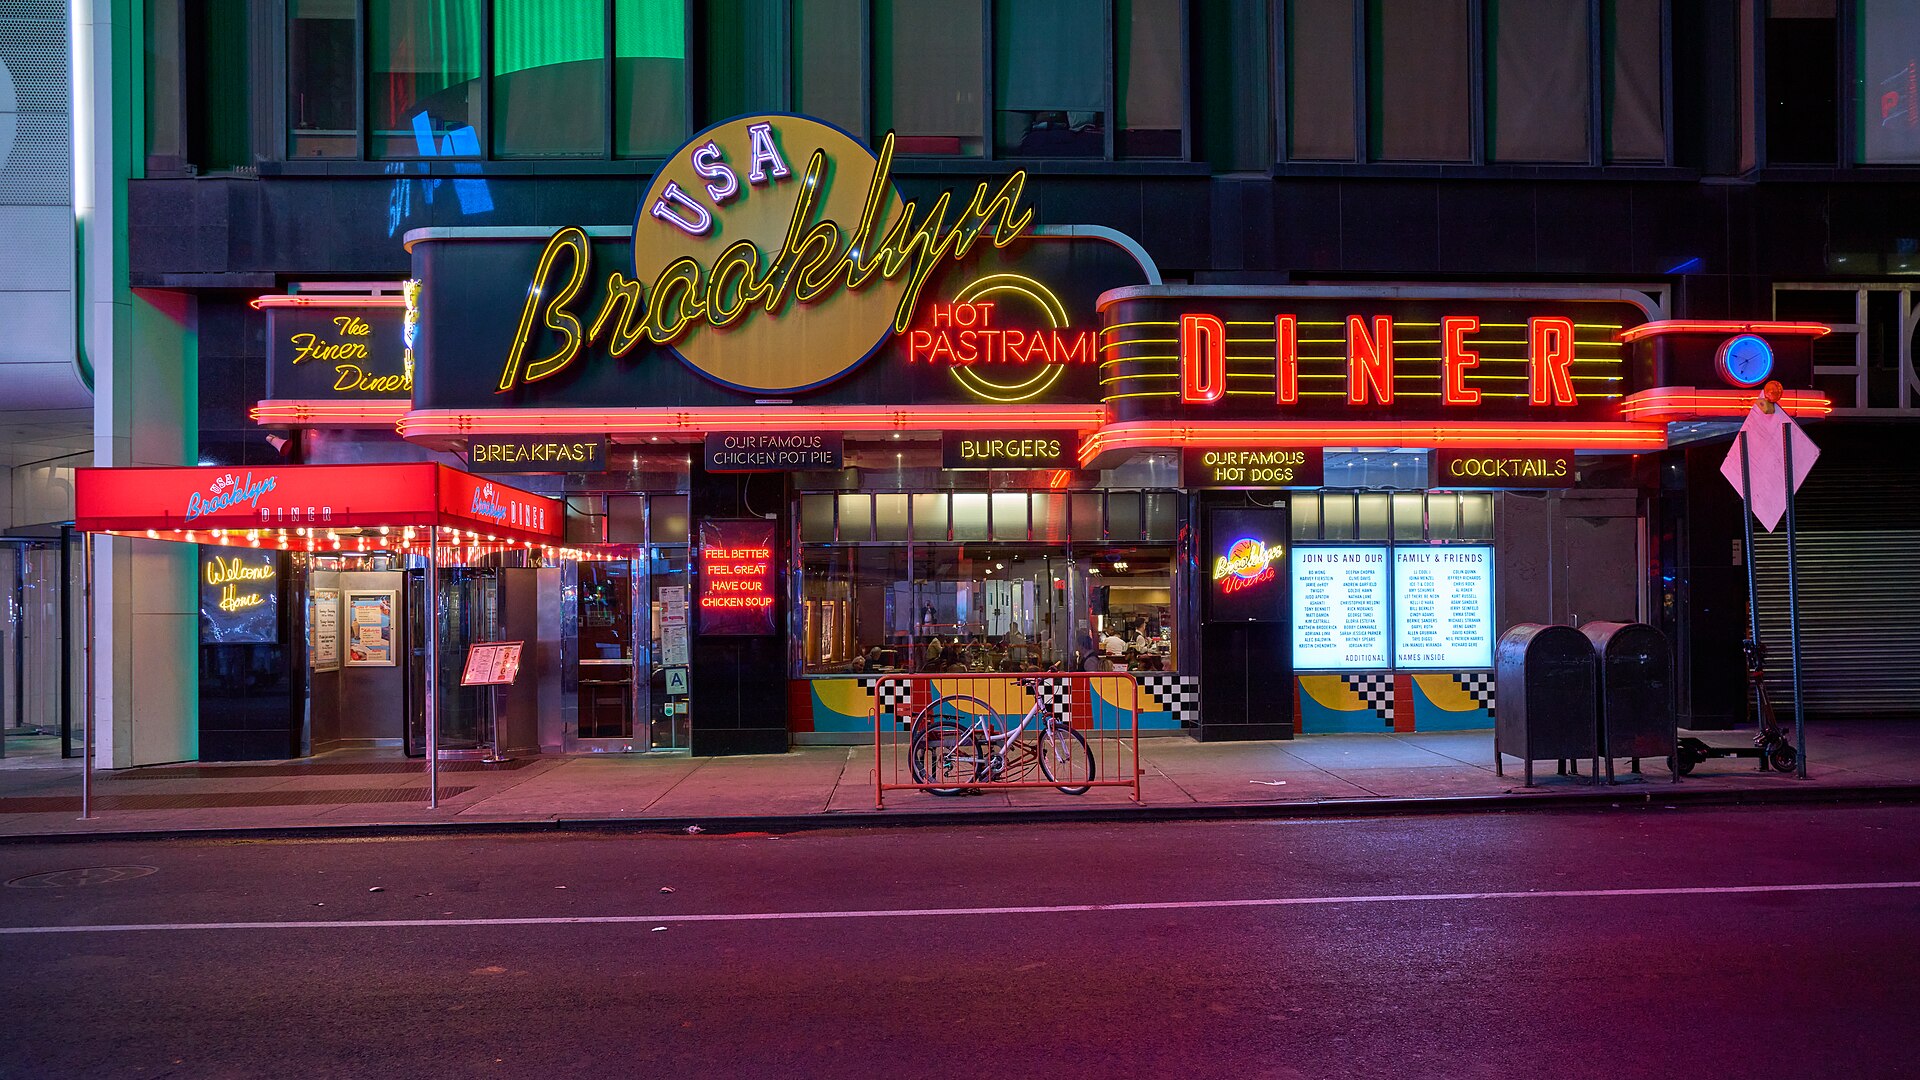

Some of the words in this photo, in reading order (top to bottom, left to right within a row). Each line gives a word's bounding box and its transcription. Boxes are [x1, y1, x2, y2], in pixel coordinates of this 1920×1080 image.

[650, 120, 792, 237] USA
[494, 127, 1036, 394] Brooklyn
[333, 316, 371, 336] The
[932, 302, 995, 330] HOT
[291, 333, 368, 364] Finer
[908, 329, 1098, 365] PASTRAMI
[1180, 312, 1578, 408] DINER
[333, 364, 413, 392] Diner
[472, 442, 598, 463] BREAKFAST
[724, 436, 756, 450] OUR
[760, 435, 822, 449] FAMOUS
[960, 439, 1062, 460] BURGERS
[713, 450, 775, 466] CHICKEN
[778, 451, 807, 465] POT
[810, 451, 833, 465] PIE
[1203, 451, 1238, 466] OUR
[1239, 451, 1306, 465] FAMOUS
[1449, 457, 1568, 478] COCKTAILS
[210, 473, 234, 494] USA
[1216, 468, 1246, 482] HOT
[1251, 468, 1295, 482] DOGS
[184, 471, 277, 523] Brooklyn
[471, 486, 507, 527] Brooklyn
[261, 506, 332, 522] DINER
[510, 500, 545, 530] DINER
[705, 549, 730, 559] FEEL
[731, 549, 770, 559] BETTER
[1213, 541, 1283, 580] Brooklyn
[1302, 554, 1323, 563] JOIN
[1327, 554, 1339, 563] US
[1343, 554, 1361, 563] AND
[1365, 554, 1383, 563] OUR
[1397, 553, 1430, 563] FAMILY
[1434, 553, 1440, 563] &
[1444, 553, 1483, 563] FRIENDS
[207, 556, 276, 586] Welcome
[708, 565, 733, 575] FEEL
[734, 565, 767, 575] GREAT
[712, 581, 739, 591] HAVE
[740, 581, 762, 591] OUR
[219, 584, 266, 612] Home
[702, 598, 744, 607] CHICKEN
[745, 598, 772, 607] SOUP
[1345, 654, 1385, 662] ADDITIONAL
[1398, 653, 1421, 661] NAMES
[1424, 653, 1445, 661] INSIDE
[670, 672, 684, 687] A
